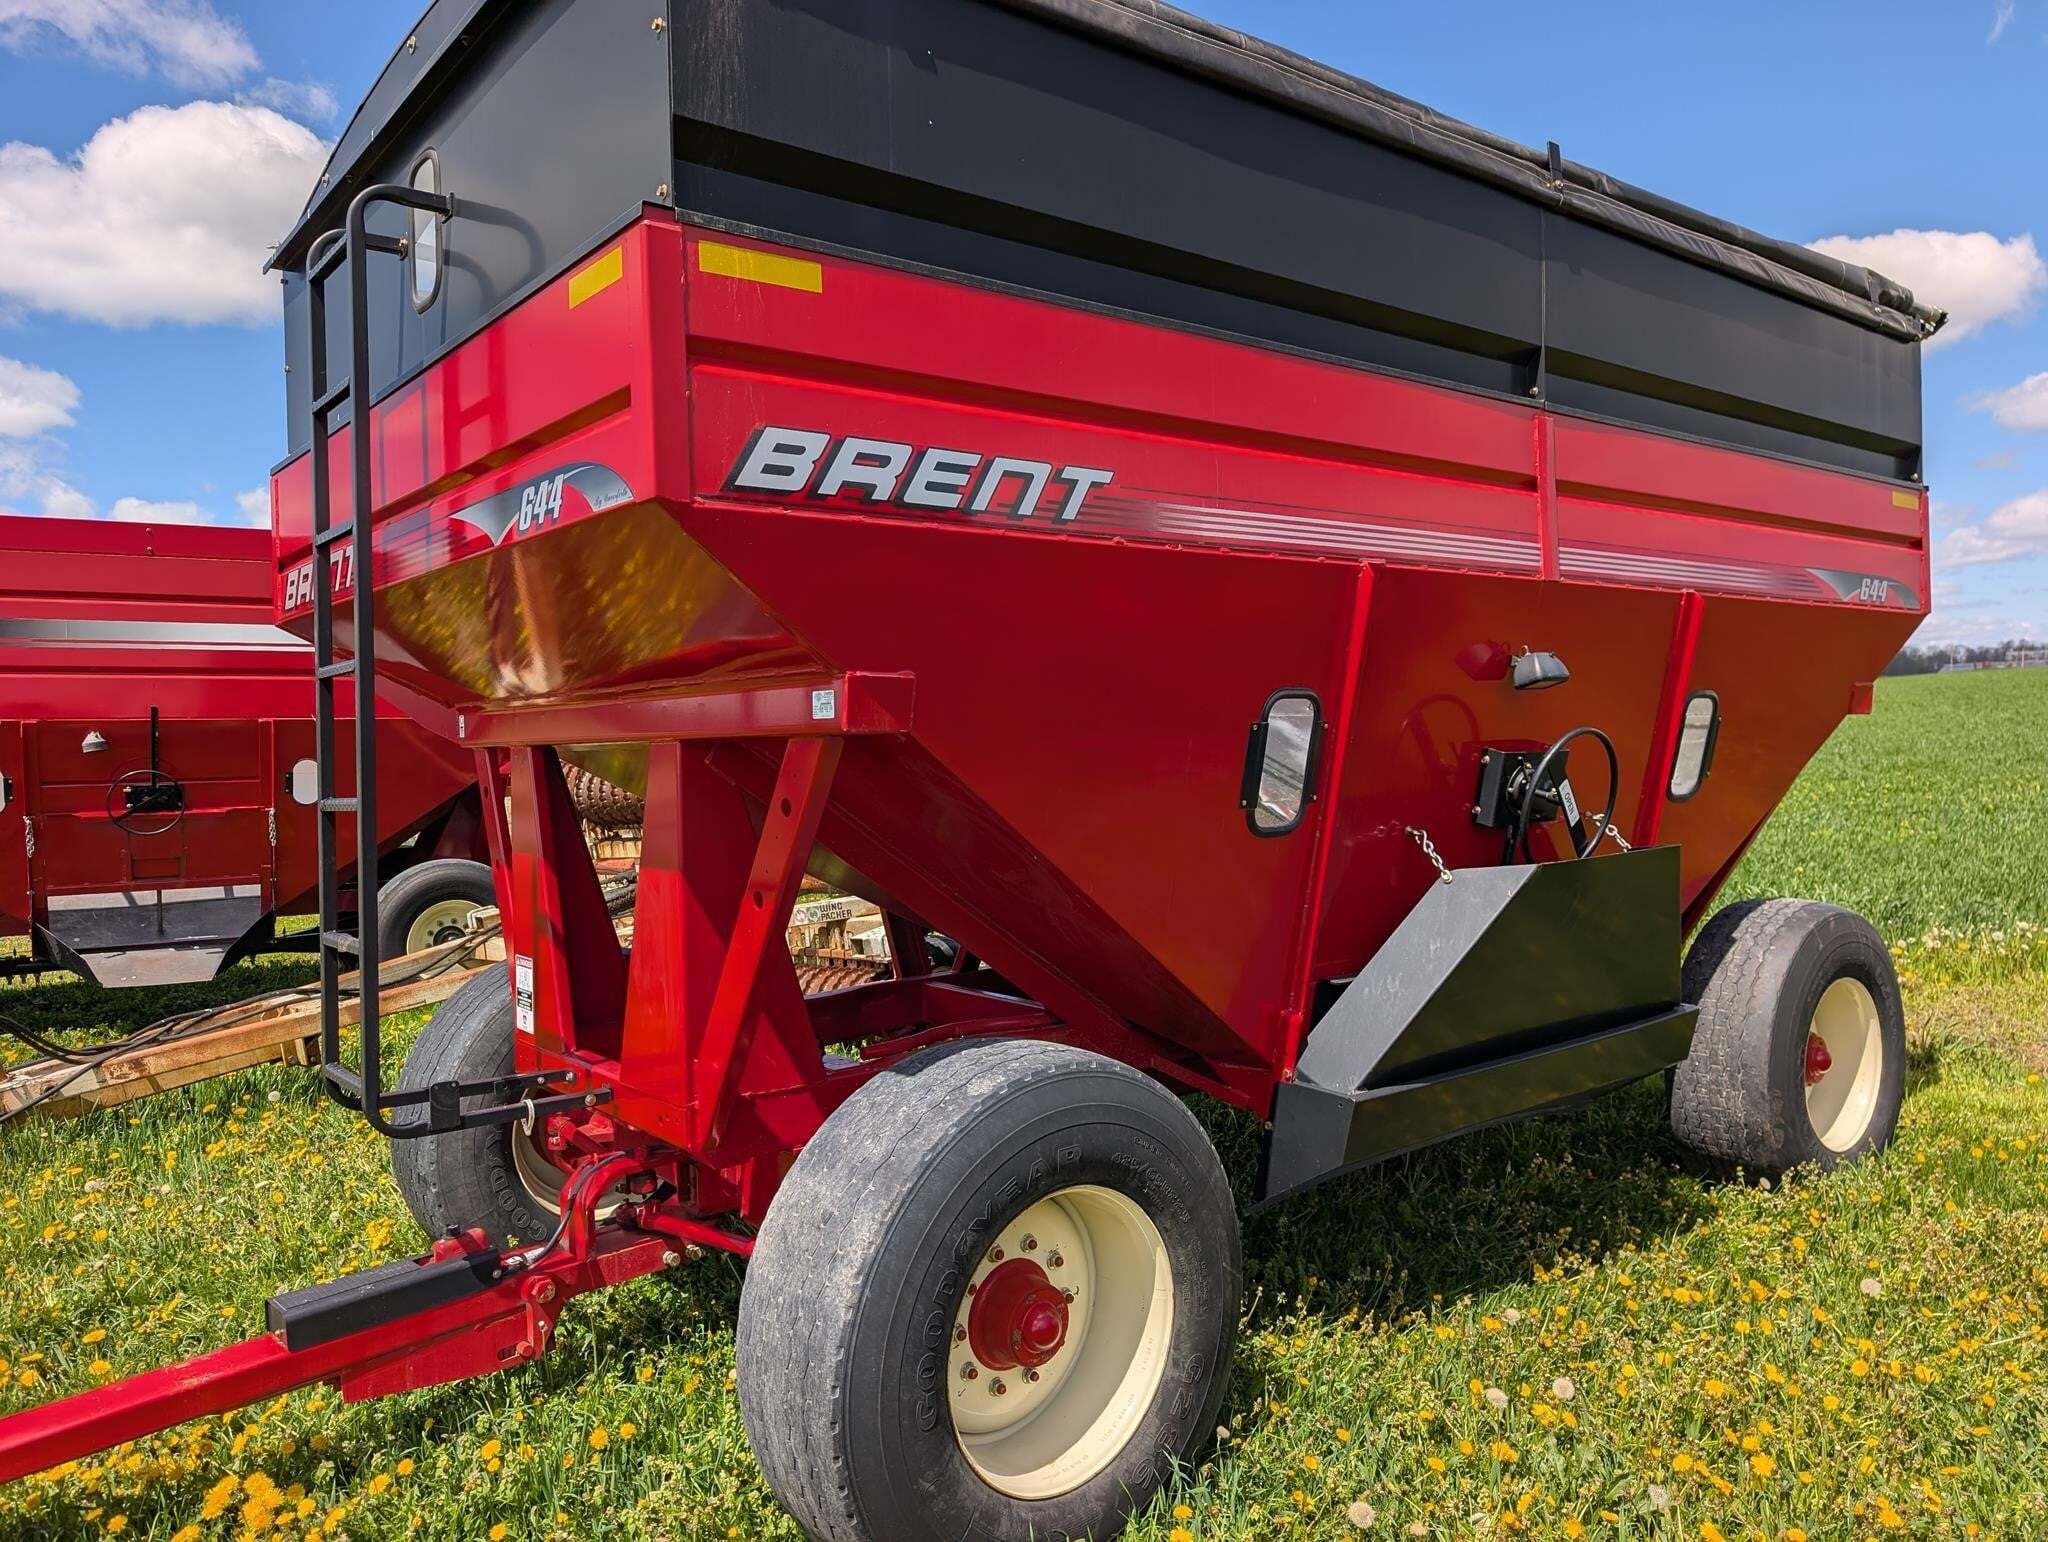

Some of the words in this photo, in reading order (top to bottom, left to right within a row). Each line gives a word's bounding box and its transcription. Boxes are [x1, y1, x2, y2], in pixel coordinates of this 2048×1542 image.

[519, 473, 565, 531] 644
[728, 425, 1114, 522] BRENT
[1860, 578, 1888, 602] 644
[1564, 792, 1575, 816] OPEN
[916, 1144, 1083, 1433] GOODYEAR
[1131, 1353, 1205, 1490] G286
